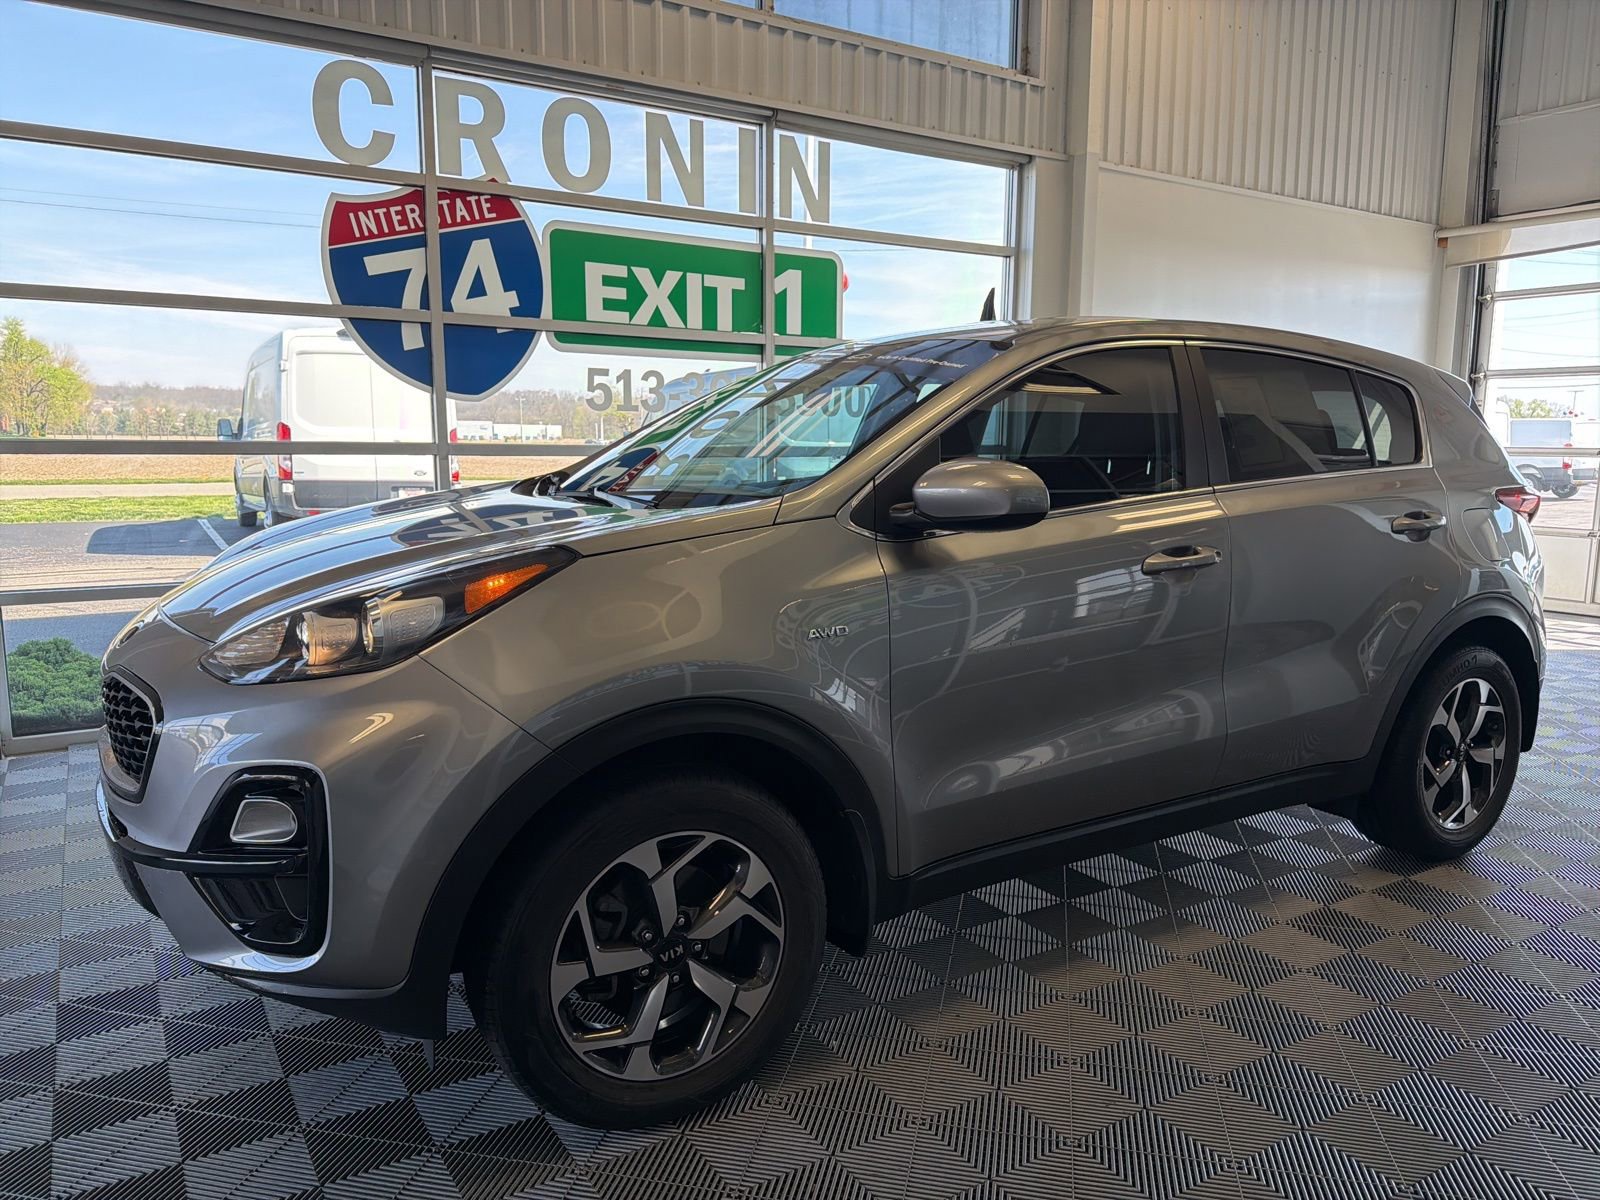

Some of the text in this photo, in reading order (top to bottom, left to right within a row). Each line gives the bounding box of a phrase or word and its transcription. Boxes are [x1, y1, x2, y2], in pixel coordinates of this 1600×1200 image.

[312, 59, 831, 224] CRONIN
[349, 194, 497, 237] INTERTATE
[363, 238, 520, 351] 74
[584, 261, 802, 335] EXIT 1
[807, 625, 850, 641] AWD
[660, 944, 684, 962] KIA
